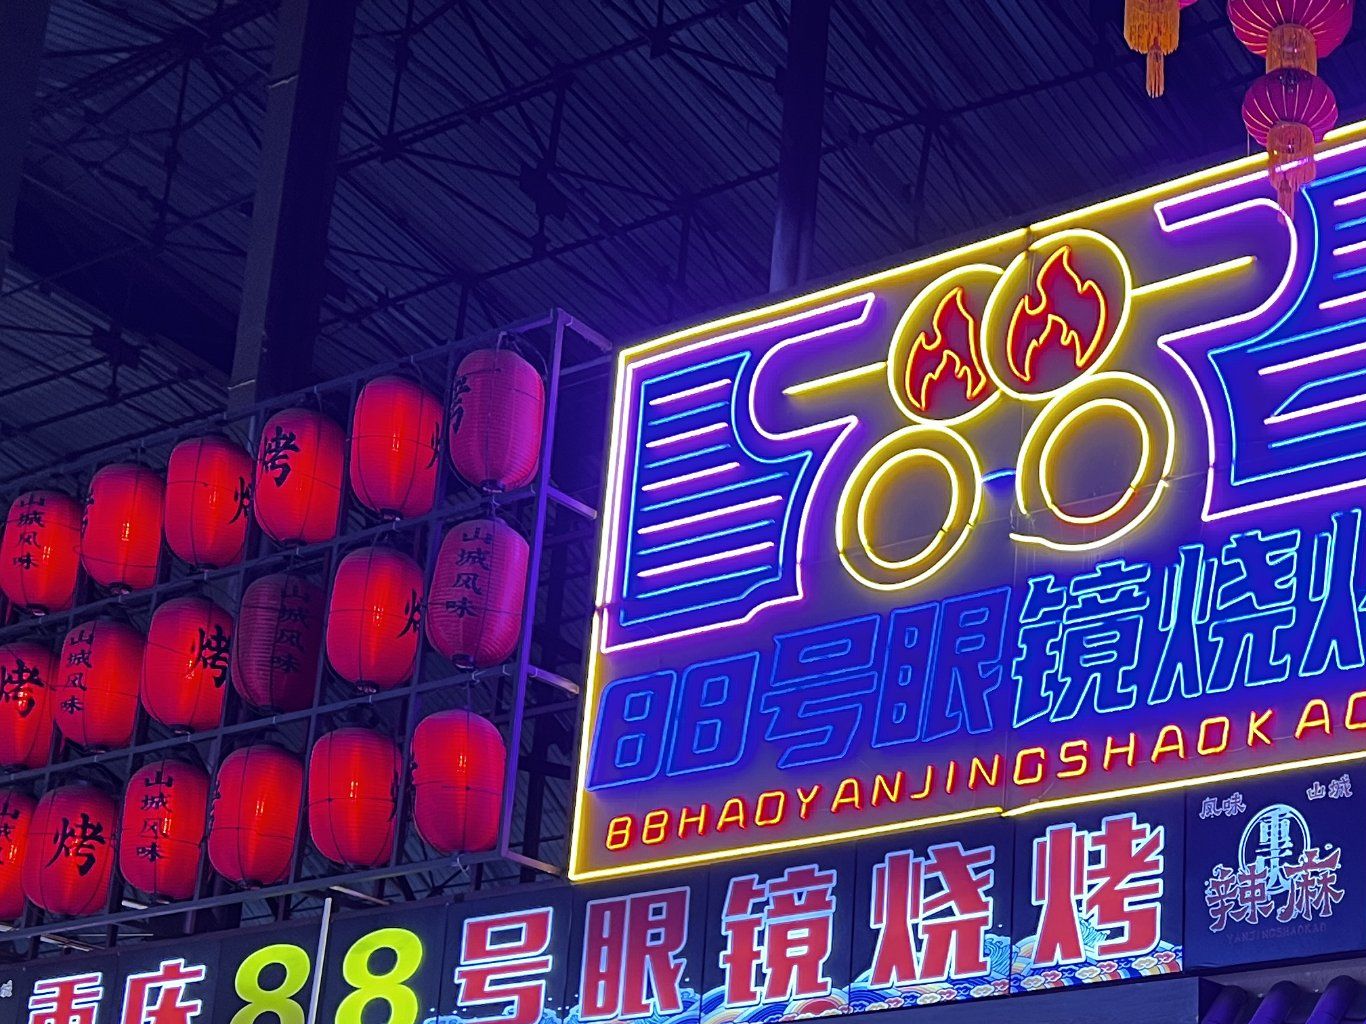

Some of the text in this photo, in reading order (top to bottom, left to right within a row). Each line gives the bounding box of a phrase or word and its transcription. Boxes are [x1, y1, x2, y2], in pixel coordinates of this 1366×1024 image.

[445, 526, 494, 619] 山城风味
[60, 629, 96, 716] 山城风味
[188, 625, 231, 690] 烤
[44, 812, 107, 877] 烤
[136, 770, 174, 863] 山城风味
